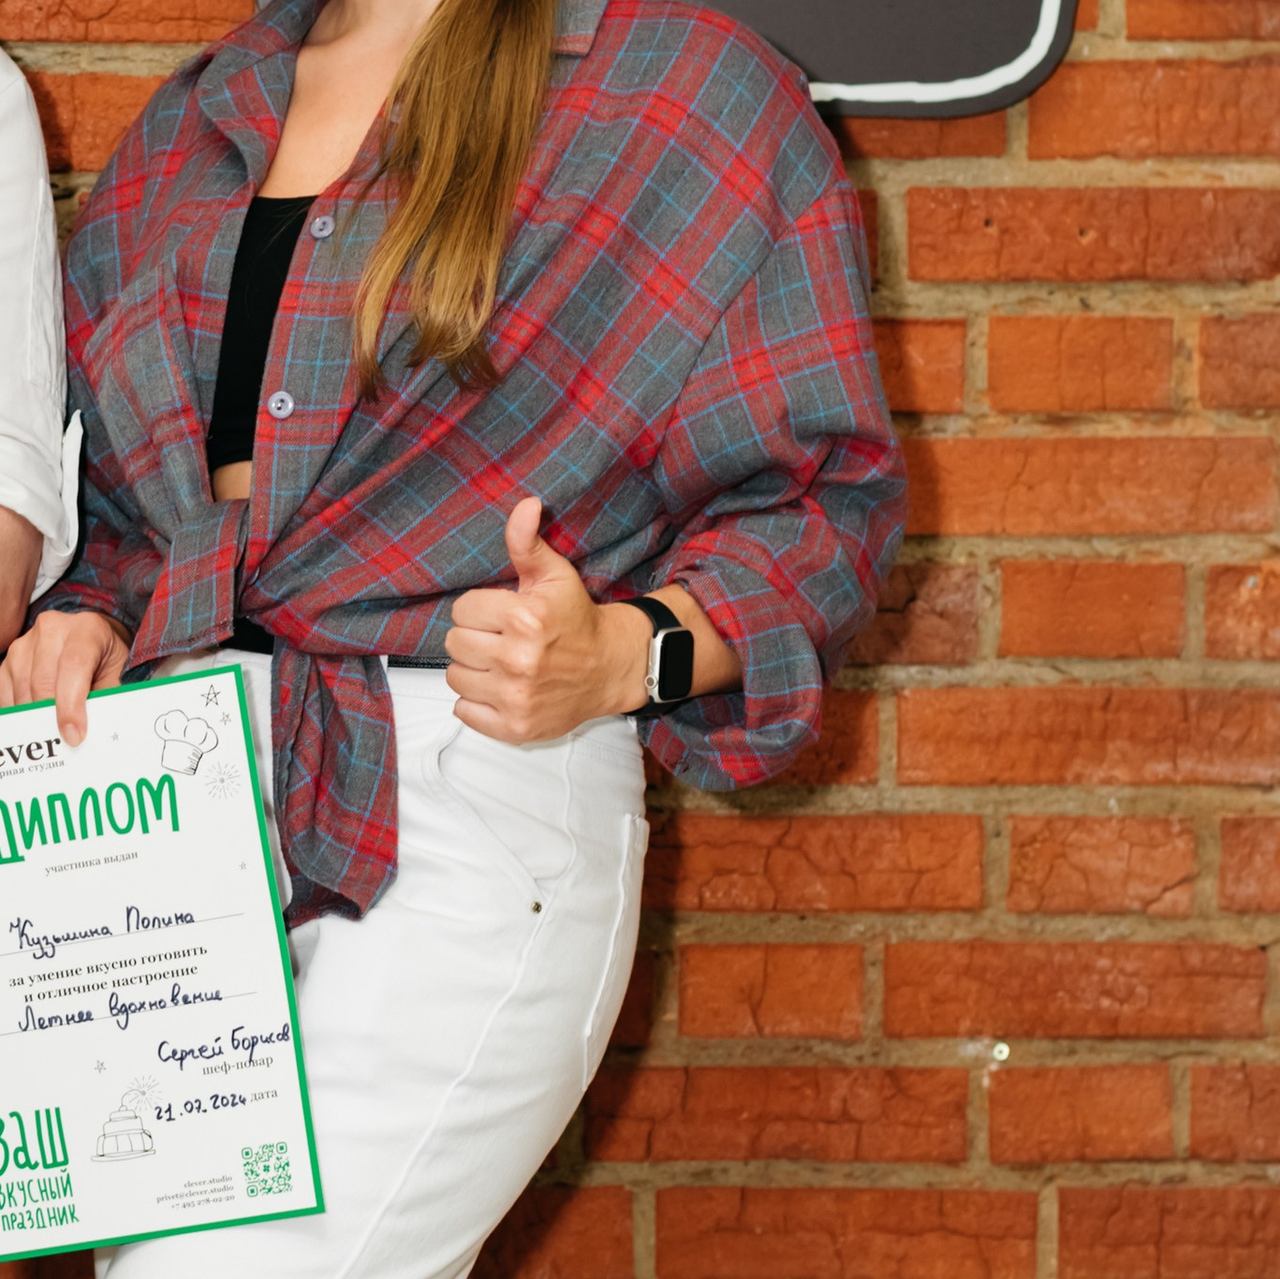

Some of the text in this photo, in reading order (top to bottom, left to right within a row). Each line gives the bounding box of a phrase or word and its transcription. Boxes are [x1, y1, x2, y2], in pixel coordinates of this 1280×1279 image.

[28, 760, 65, 775] студия
[45, 851, 138, 876] участника выдан
[9, 946, 208, 988] за умение вкусно готовить
[24, 965, 198, 1003] и отличное настроение
[158, 1037, 224, 1071] Сергей
[202, 1056, 274, 1075] шеф-повар
[250, 1089, 278, 1103] дата
